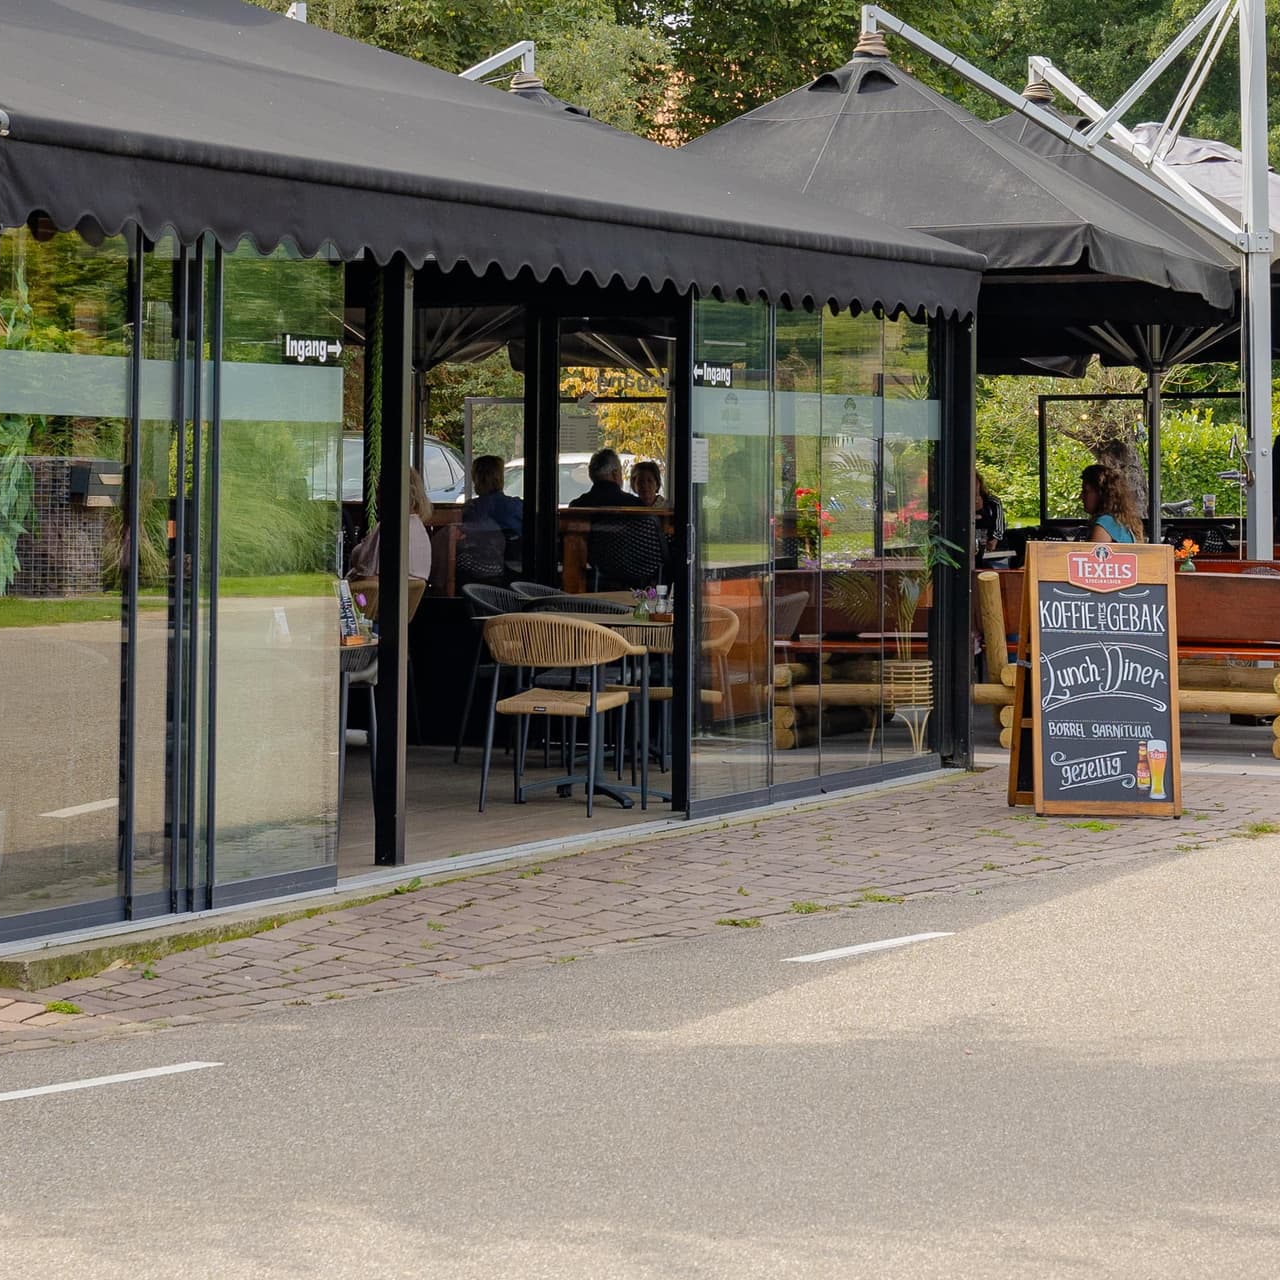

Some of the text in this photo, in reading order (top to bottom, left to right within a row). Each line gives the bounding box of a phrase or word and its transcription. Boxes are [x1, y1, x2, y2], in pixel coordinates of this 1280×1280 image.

[285, 333, 327, 363] Ingang
[703, 362, 731, 387] Ingang
[1072, 558, 1132, 579] TEXELS
[1107, 602, 1165, 632] GEBAK
[1099, 640, 1164, 693] Diner
[1048, 722, 1086, 737] BORREL
[1061, 757, 1121, 786] gezellig
